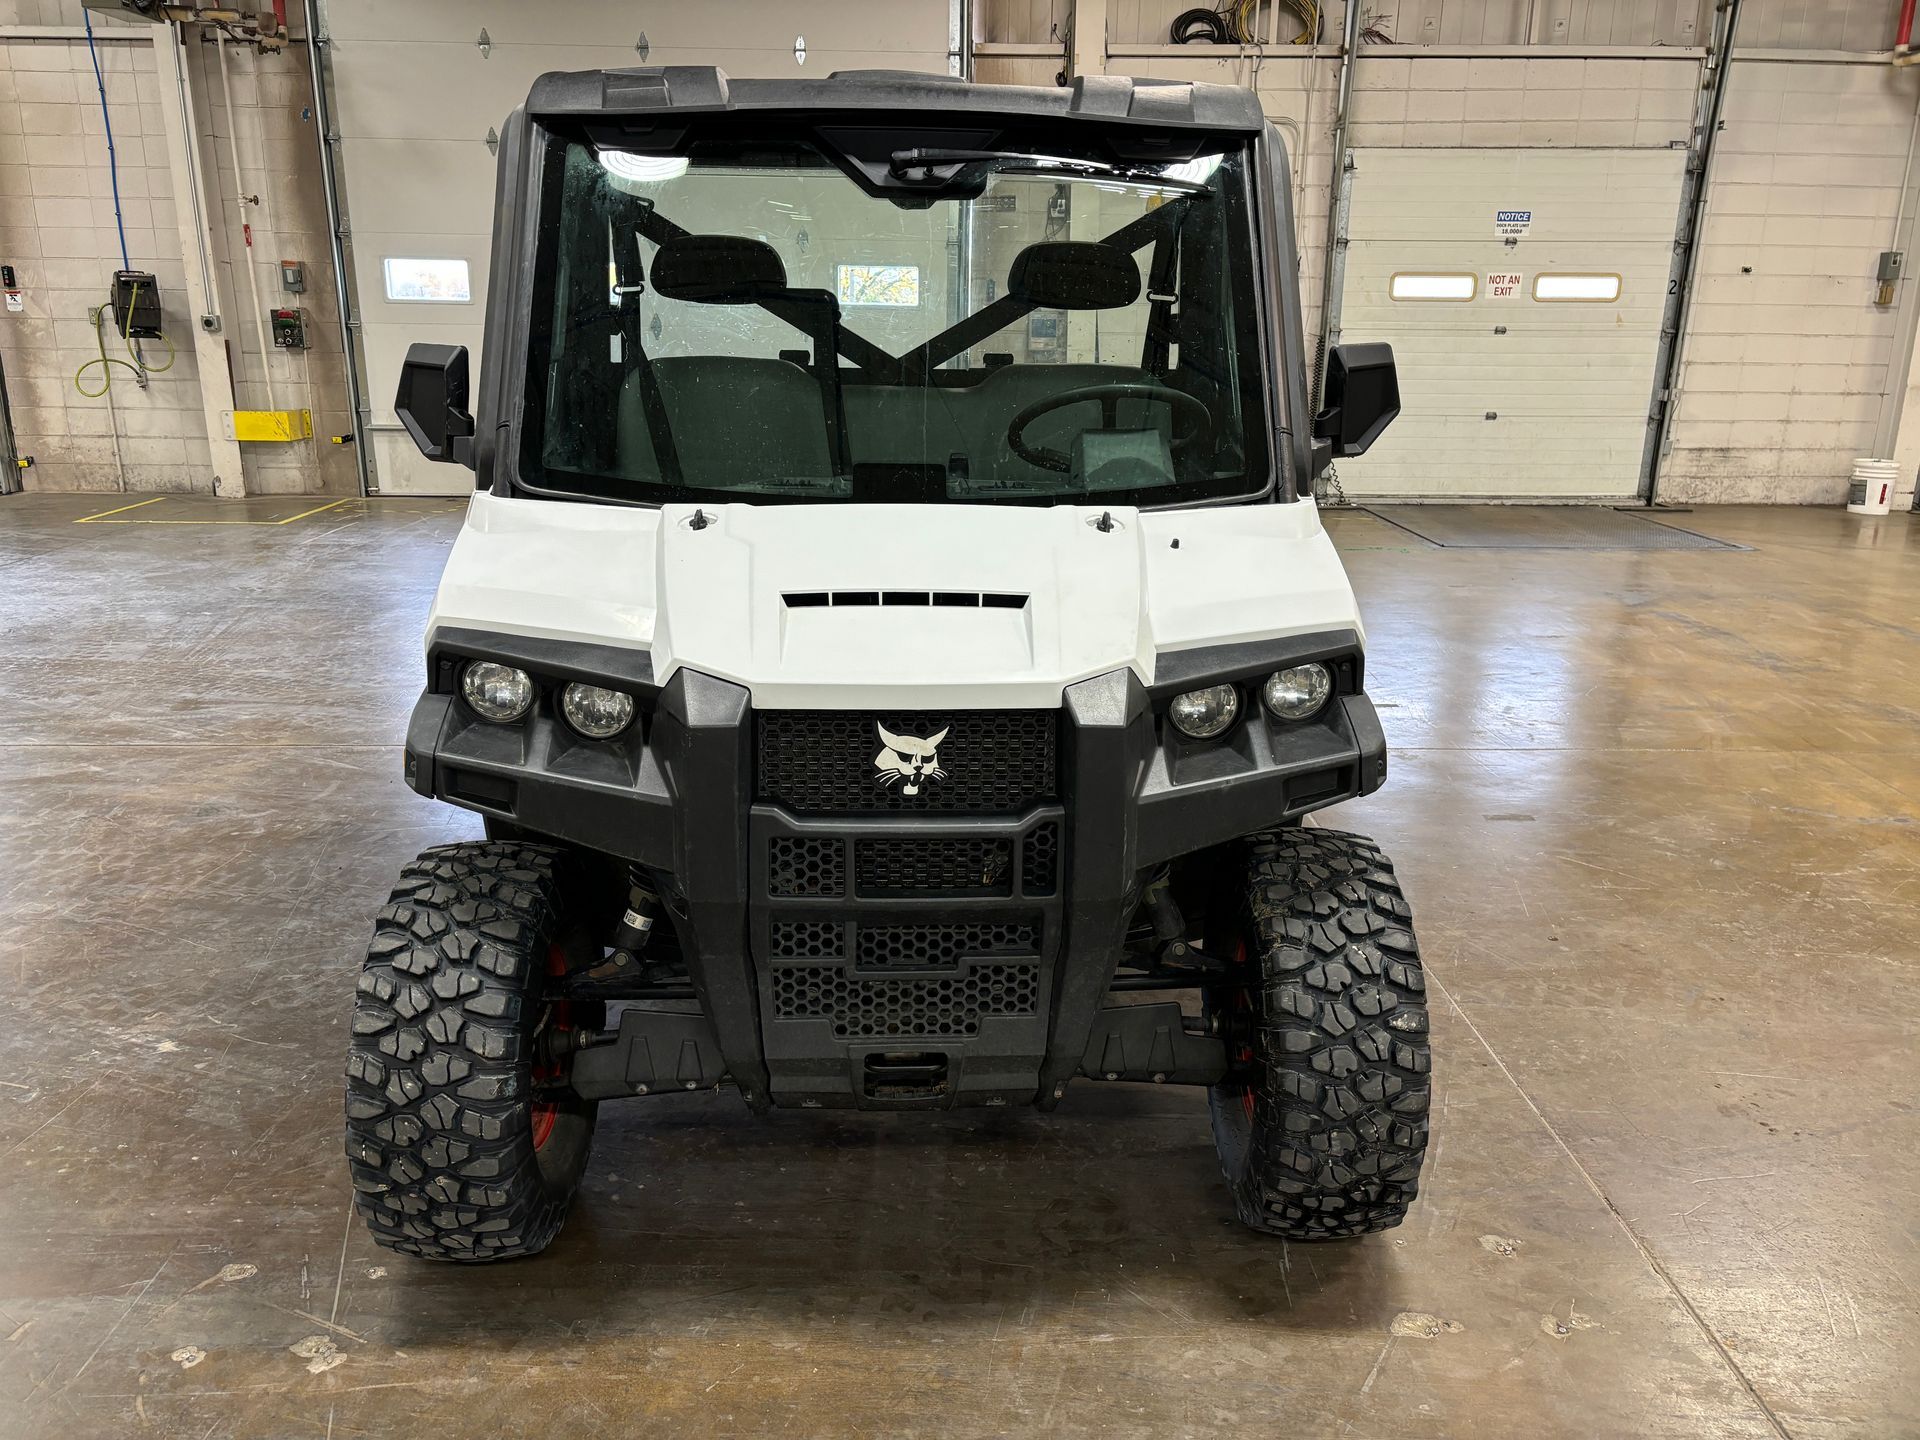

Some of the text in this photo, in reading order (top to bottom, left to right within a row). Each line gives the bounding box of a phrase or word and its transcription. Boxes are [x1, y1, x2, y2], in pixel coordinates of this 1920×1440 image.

[1498, 212, 1530, 221] NOTICE
[1488, 275, 1521, 285] NOT AN
[1493, 286, 1513, 296] EXIT
[1668, 279, 1677, 295] 2
